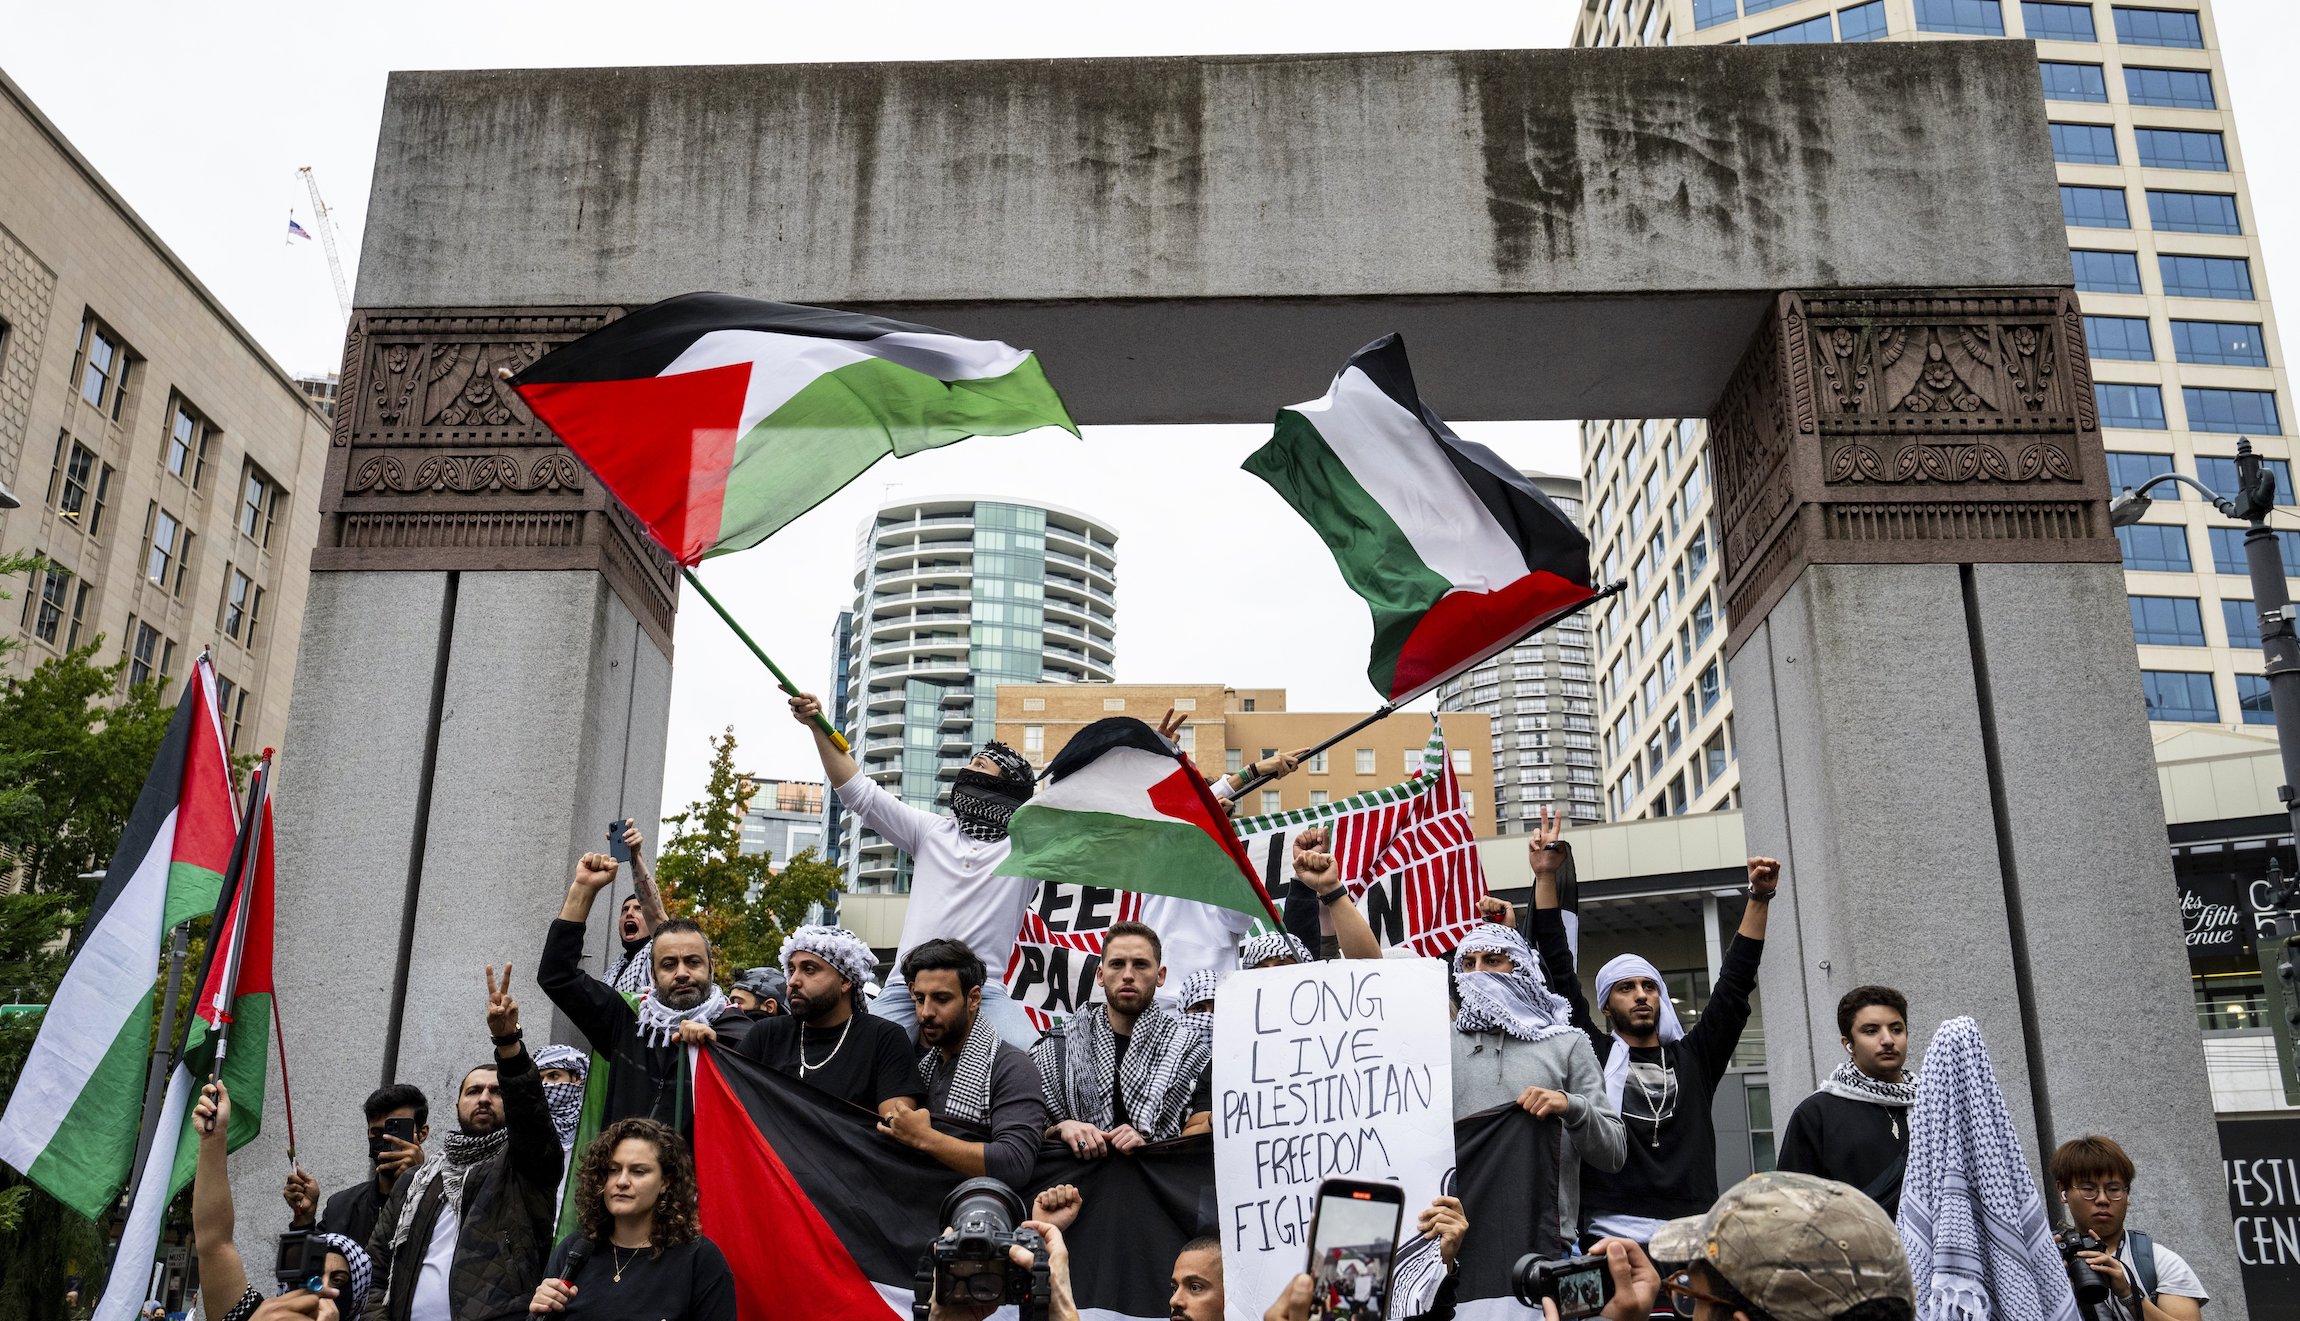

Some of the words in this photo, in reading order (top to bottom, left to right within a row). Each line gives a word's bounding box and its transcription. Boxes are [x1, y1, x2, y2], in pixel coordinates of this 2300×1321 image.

[1028, 880, 1115, 932] EE
[2185, 929, 2233, 946] enue
[1010, 945, 1102, 1014] PAL
[1255, 971, 1384, 1034] LONG
[1251, 1028, 1384, 1084] LIVE
[1223, 1064, 1432, 1138] PALESTINIAN
[1255, 1127, 1391, 1189] FREEDOM
[1235, 1195, 1314, 1252] FIGH
[2233, 1216, 2300, 1265] CEN
